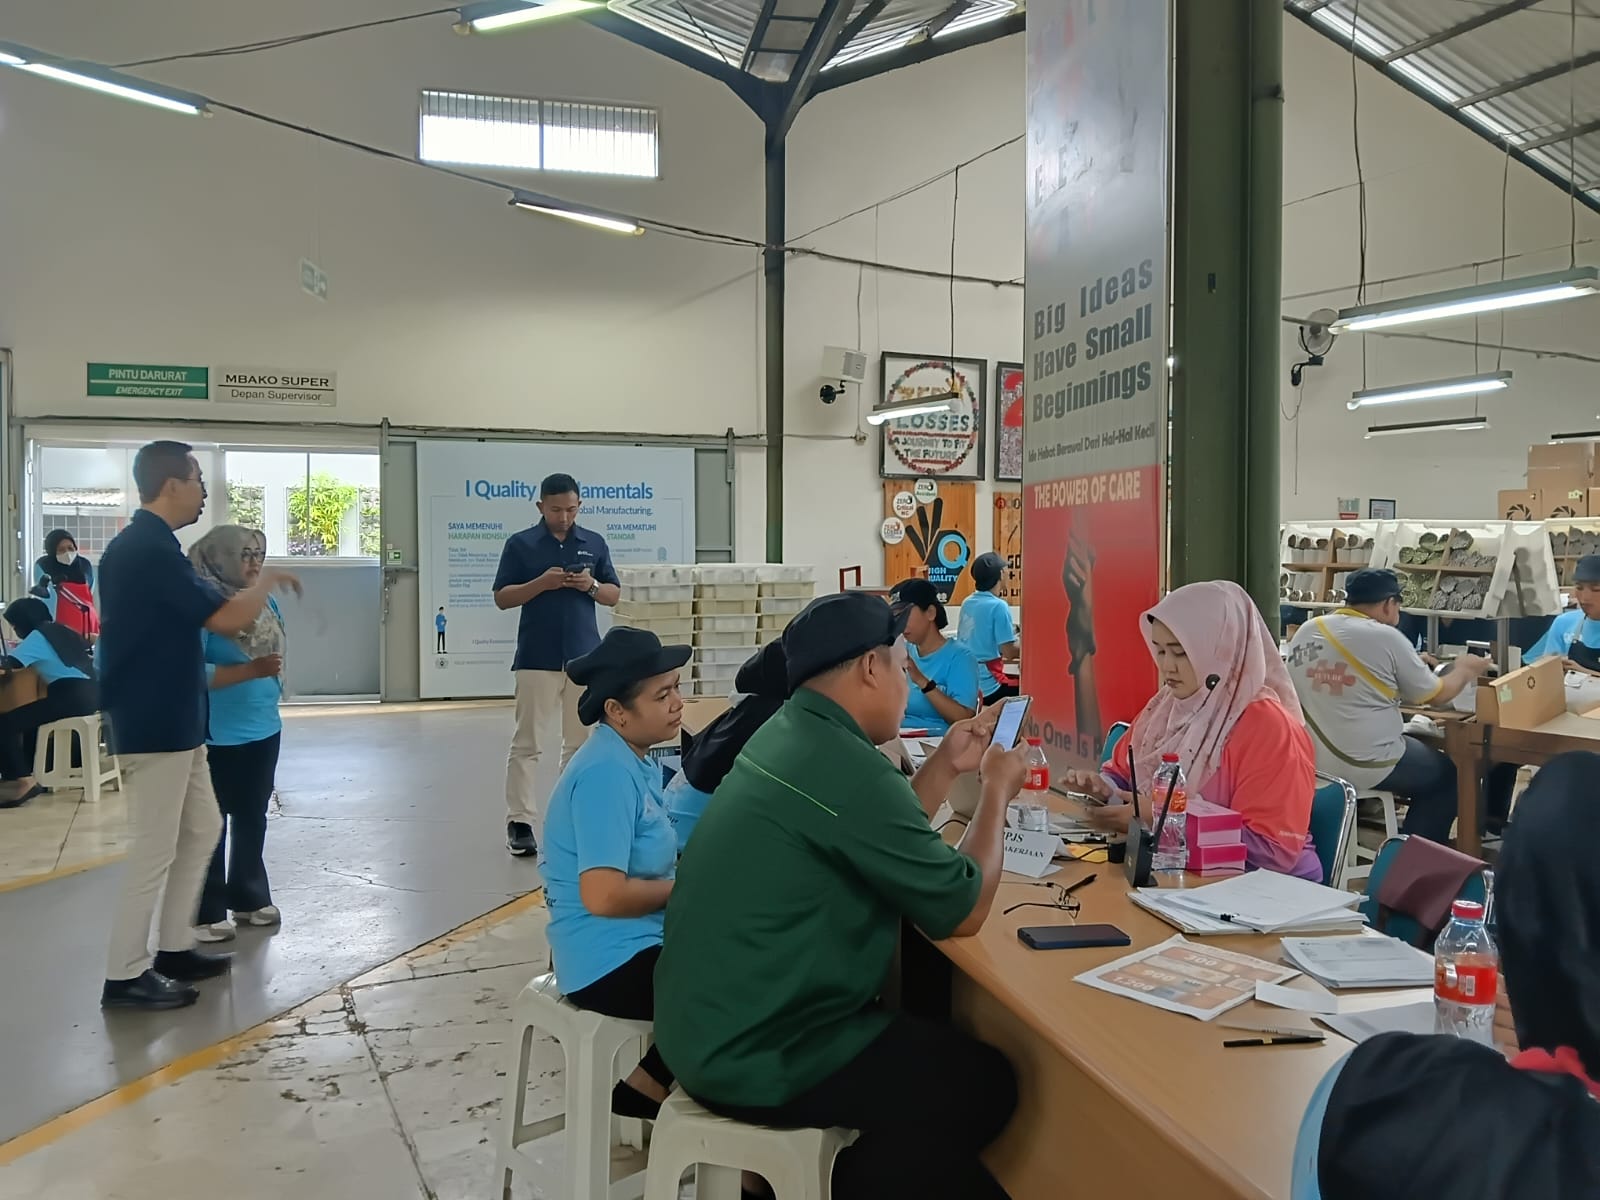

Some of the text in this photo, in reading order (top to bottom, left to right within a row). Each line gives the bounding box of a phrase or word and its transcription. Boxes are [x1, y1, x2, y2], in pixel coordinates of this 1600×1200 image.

[1034, 259, 1152, 340] Big Ideas
[1033, 303, 1152, 381] Have Small
[108, 368, 187, 381] PINTU DARURAT
[225, 374, 329, 387] MBAKO SUPER
[115, 386, 183, 396] EMERGENCY EXIT
[231, 389, 322, 401] Depan Supervisor
[1033, 361, 1152, 423] Beginnings
[897, 413, 970, 432] LOSSES
[1084, 434, 1100, 450] Dari
[475, 479, 537, 501] Quality
[1034, 470, 1141, 510] THE POWER OF CARE
[597, 506, 654, 516] Manufacturing.
[448, 522, 503, 530] SAYA MEMENUHI
[606, 523, 657, 532] SAYA MEMATUHI
[1043, 721, 1072, 752] One
[1076, 733, 1089, 759] Is
[1003, 831, 1025, 843] PJS
